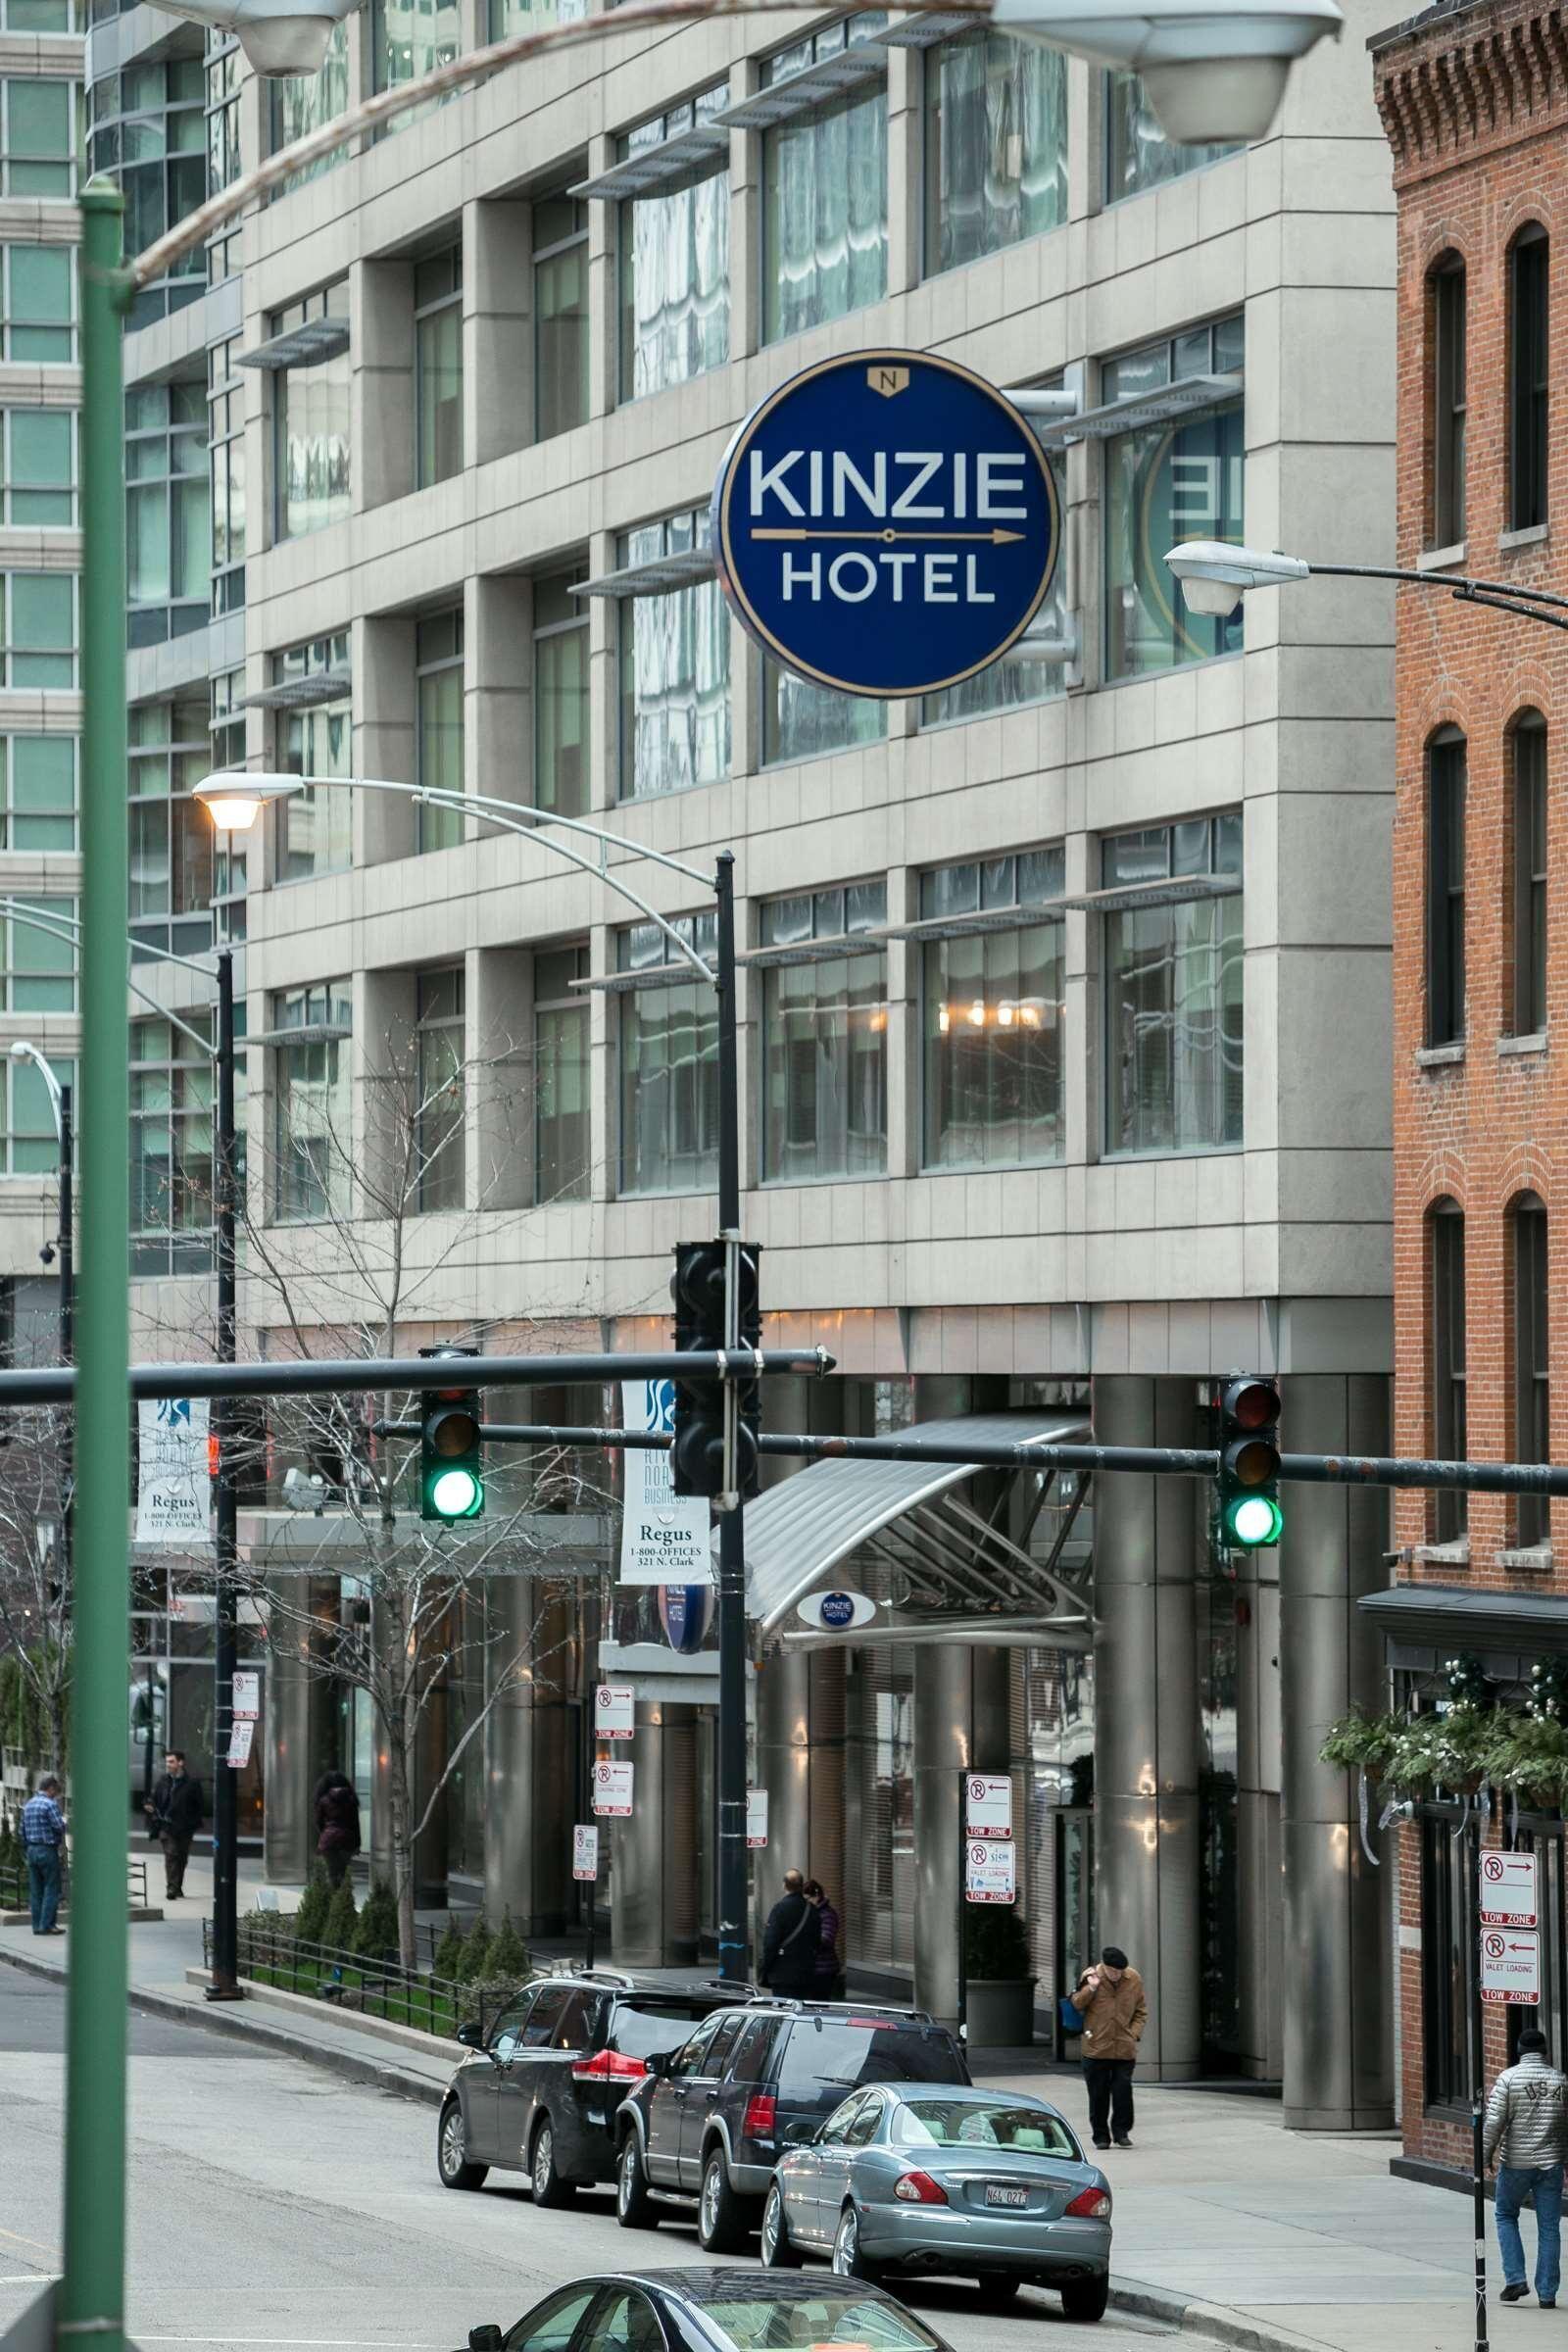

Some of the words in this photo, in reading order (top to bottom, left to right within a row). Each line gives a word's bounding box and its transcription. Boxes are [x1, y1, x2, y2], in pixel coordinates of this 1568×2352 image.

[880, 370, 897, 390] N
[750, 450, 1027, 519] KINZIE
[782, 551, 996, 603] HOTEL
[152, 1494, 195, 1511] Regus
[640, 1525, 692, 1546] Regus
[630, 1547, 702, 1556] 1-800-OFFICES
[637, 1557, 653, 1566] 321
[669, 1557, 695, 1566] Clark
[823, 1601, 852, 1610] KINZIE
[970, 1827, 985, 1836] TOW
[988, 1828, 1007, 1837] ZONE
[970, 1891, 986, 1900] TOW
[989, 1892, 1011, 1901] ZONE
[1485, 1913, 1503, 1922] TOW
[1507, 1914, 1532, 1924] ZONE
[1506, 1965, 1533, 1974] LOADING
[1486, 1990, 1505, 1999] TOW
[1509, 1991, 1535, 2002] ZONE
[1523, 2082, 1562, 2101] USA
